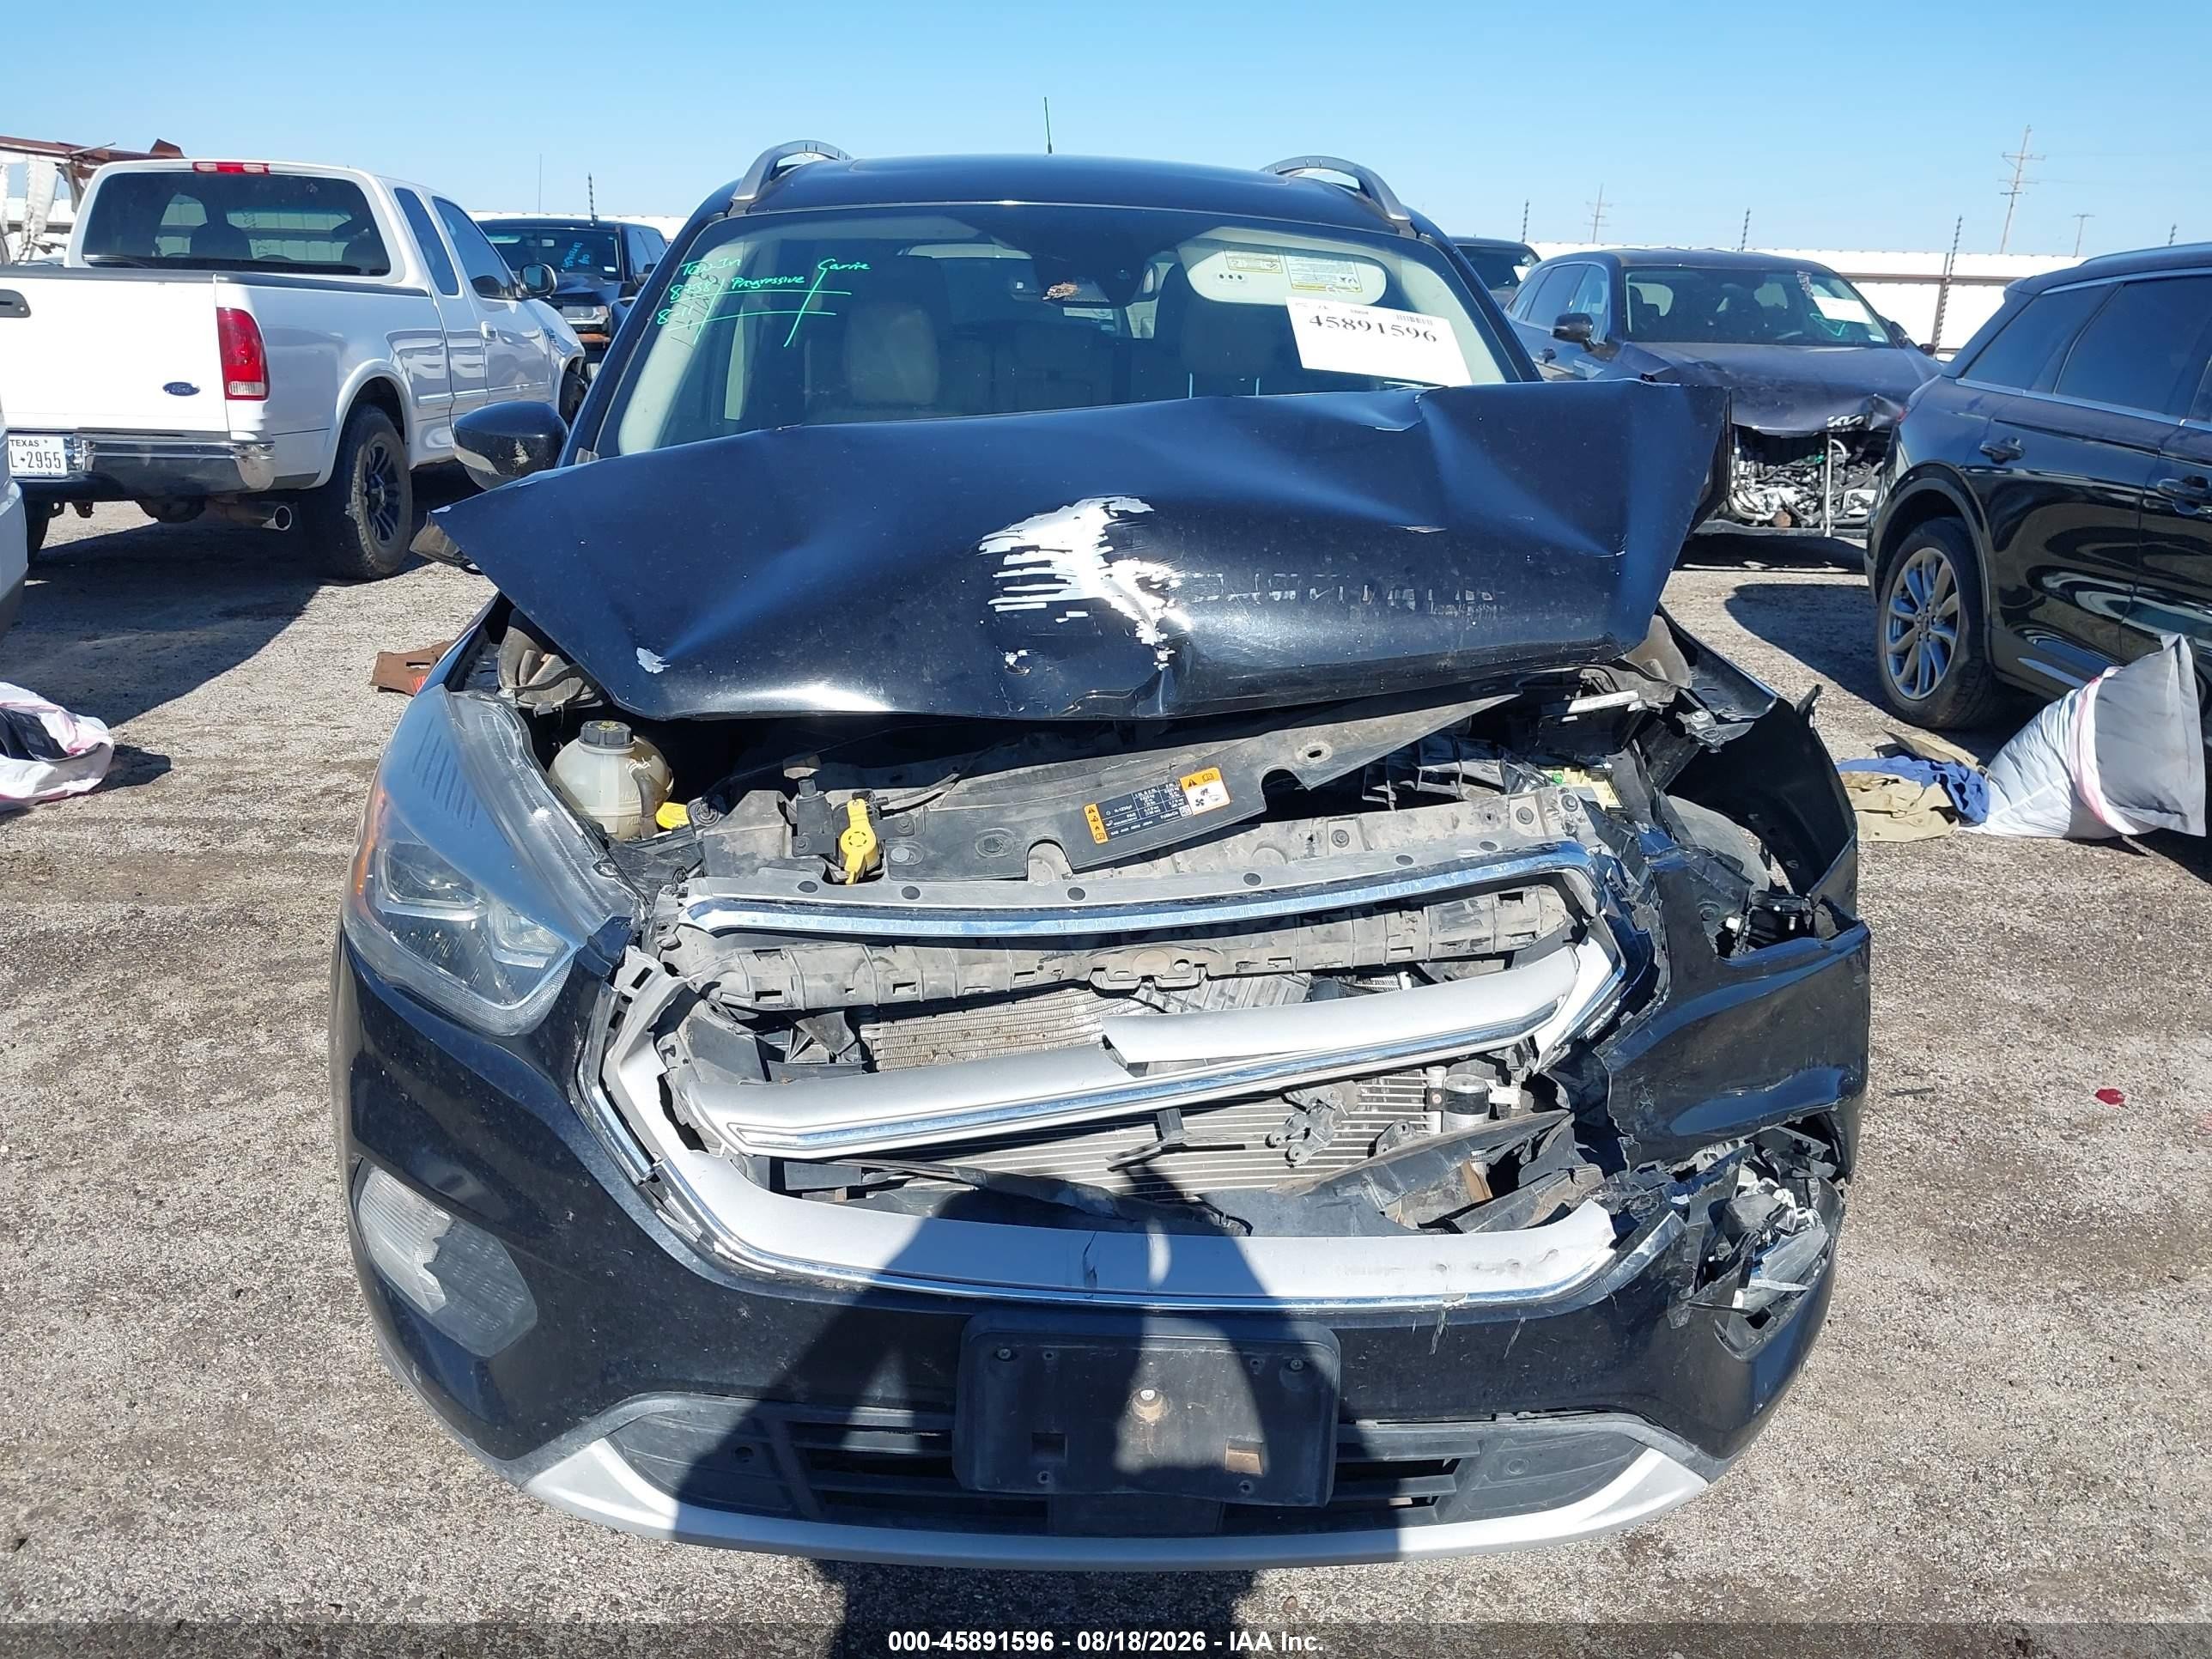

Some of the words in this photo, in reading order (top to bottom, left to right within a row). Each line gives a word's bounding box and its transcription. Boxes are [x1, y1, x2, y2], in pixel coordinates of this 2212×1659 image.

[732, 276, 805, 290] Progressive
[1309, 314, 1437, 343] 45891596
[9, 439, 40, 447] TEXAS
